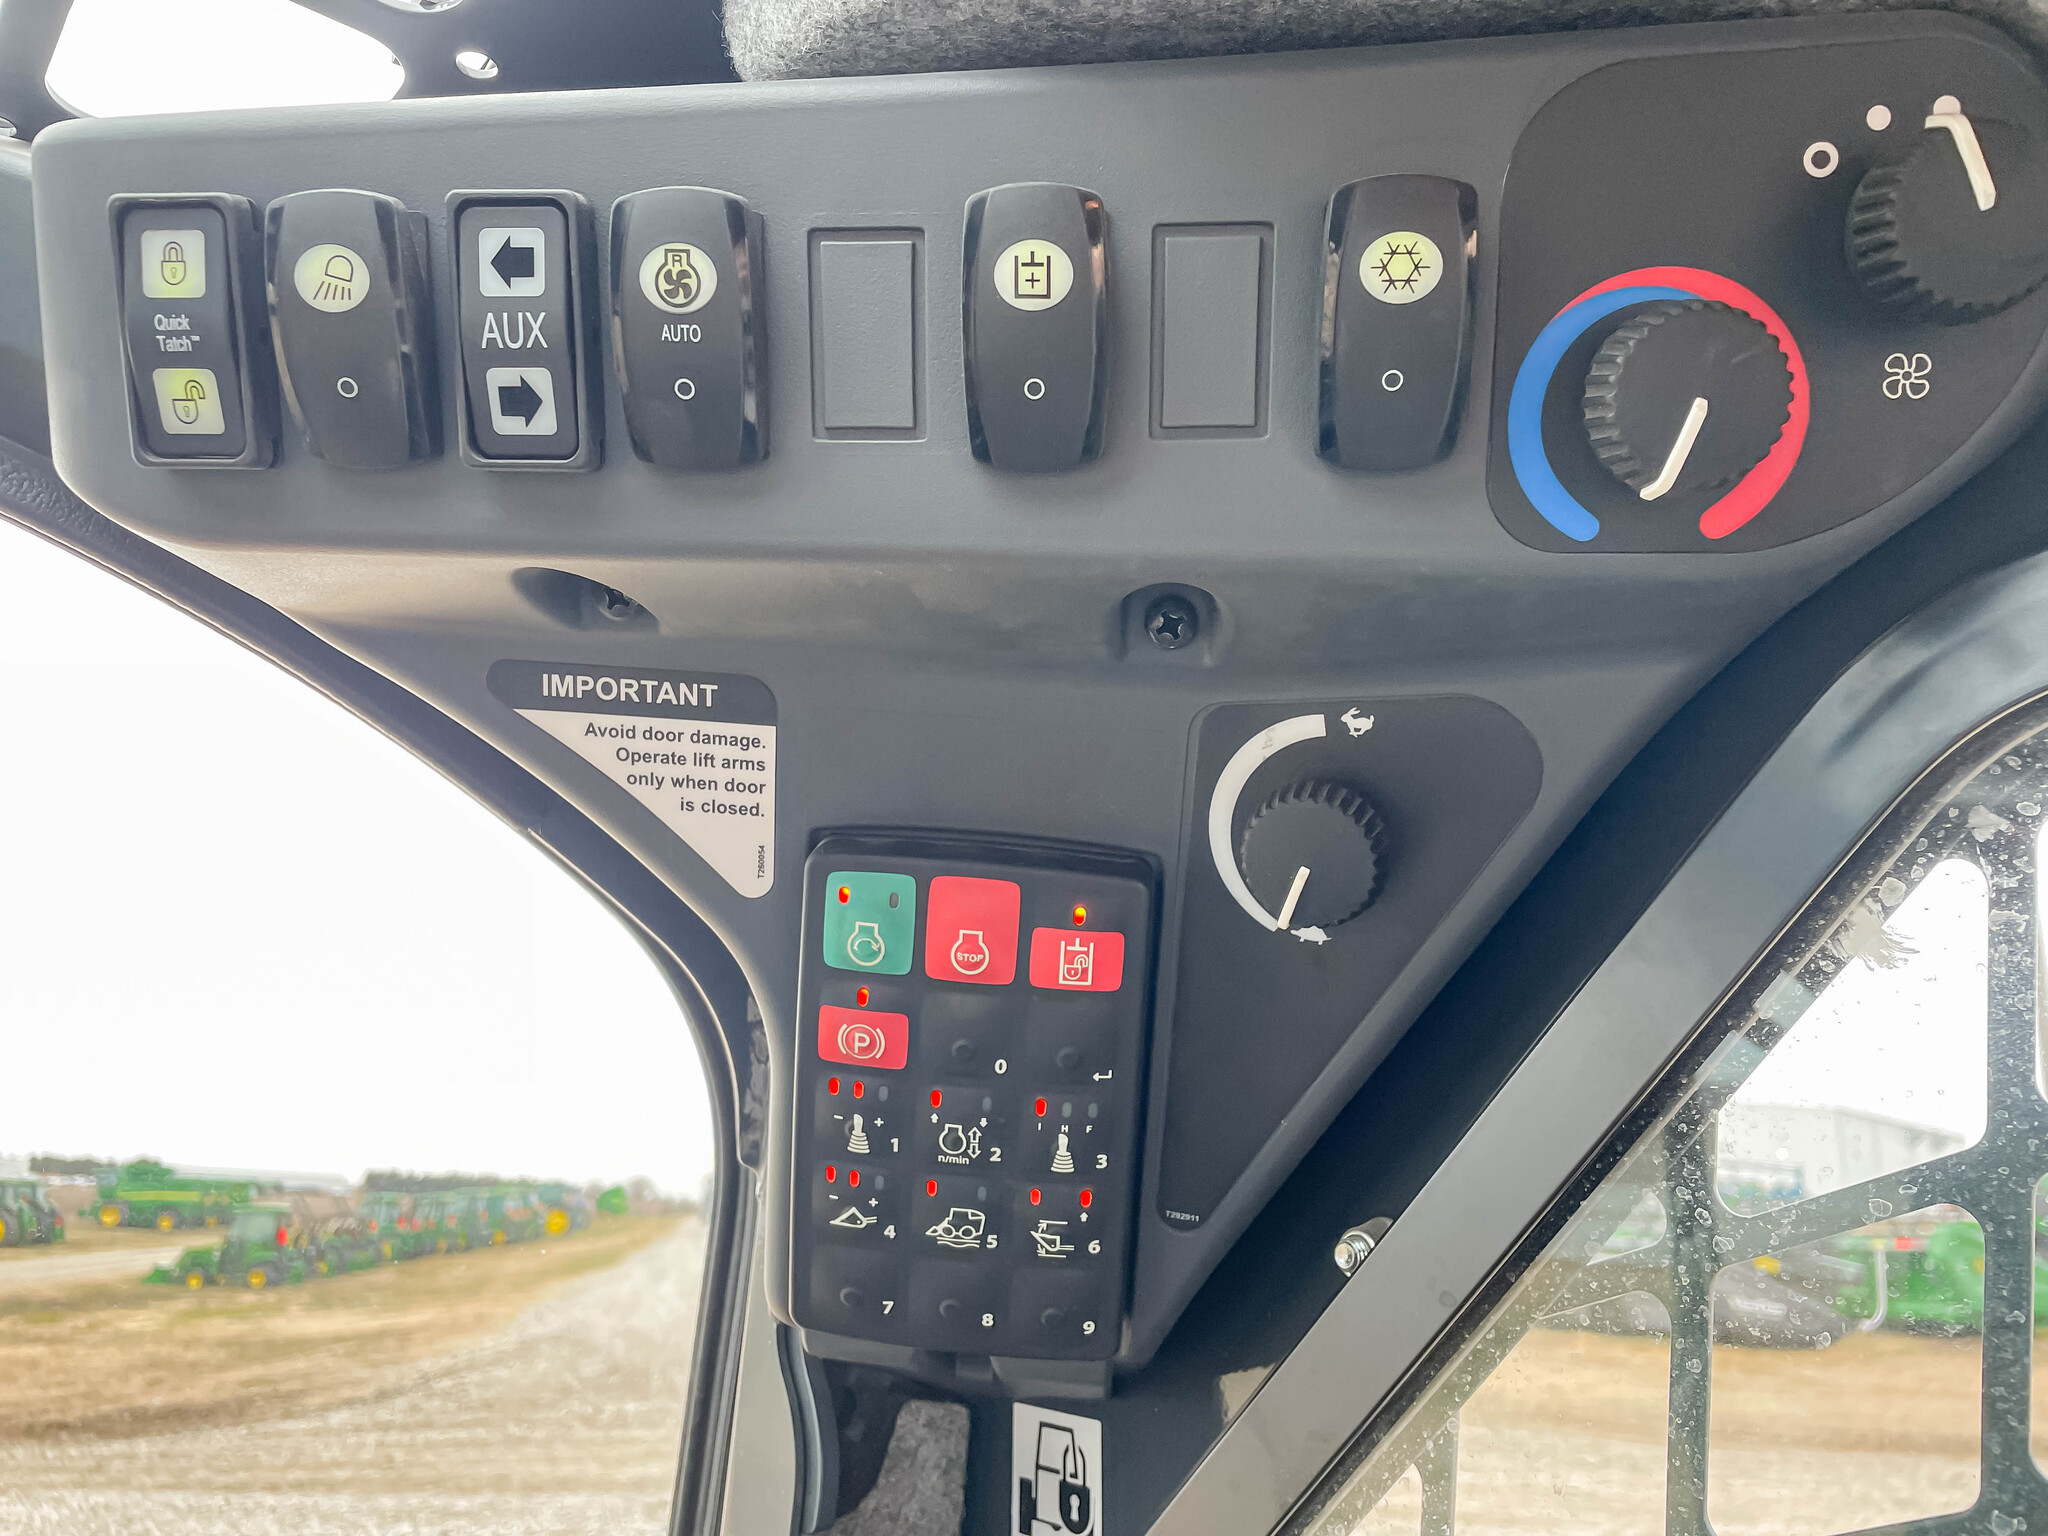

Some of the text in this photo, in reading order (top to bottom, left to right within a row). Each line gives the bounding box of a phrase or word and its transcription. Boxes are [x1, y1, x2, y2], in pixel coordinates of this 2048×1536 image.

[671, 253, 683, 268] R
[153, 313, 191, 331] Quick
[481, 311, 549, 350] AUX
[661, 323, 702, 343] AUTO
[542, 673, 718, 707] IMPORTANT
[584, 722, 767, 751] Avoid door damage.
[615, 747, 766, 772] Operate lift arms
[626, 772, 767, 795] only when door
[679, 797, 766, 818] is closed.
[757, 844, 766, 879] T260054
[956, 951, 985, 964] STOP
[853, 1032, 871, 1053] P
[994, 1059, 1008, 1074] 0
[1060, 1124, 1069, 1134] H
[1084, 1125, 1093, 1134] F
[889, 1137, 900, 1153] 1
[937, 1153, 970, 1166] n/min
[988, 1147, 1003, 1163] 2
[1095, 1154, 1108, 1170] 3
[883, 1225, 897, 1240] 4
[985, 1234, 999, 1249] 5
[1086, 1240, 1101, 1255] 6
[881, 1300, 895, 1315] 7
[980, 1312, 995, 1328] 8
[1081, 1320, 1096, 1336] 9
